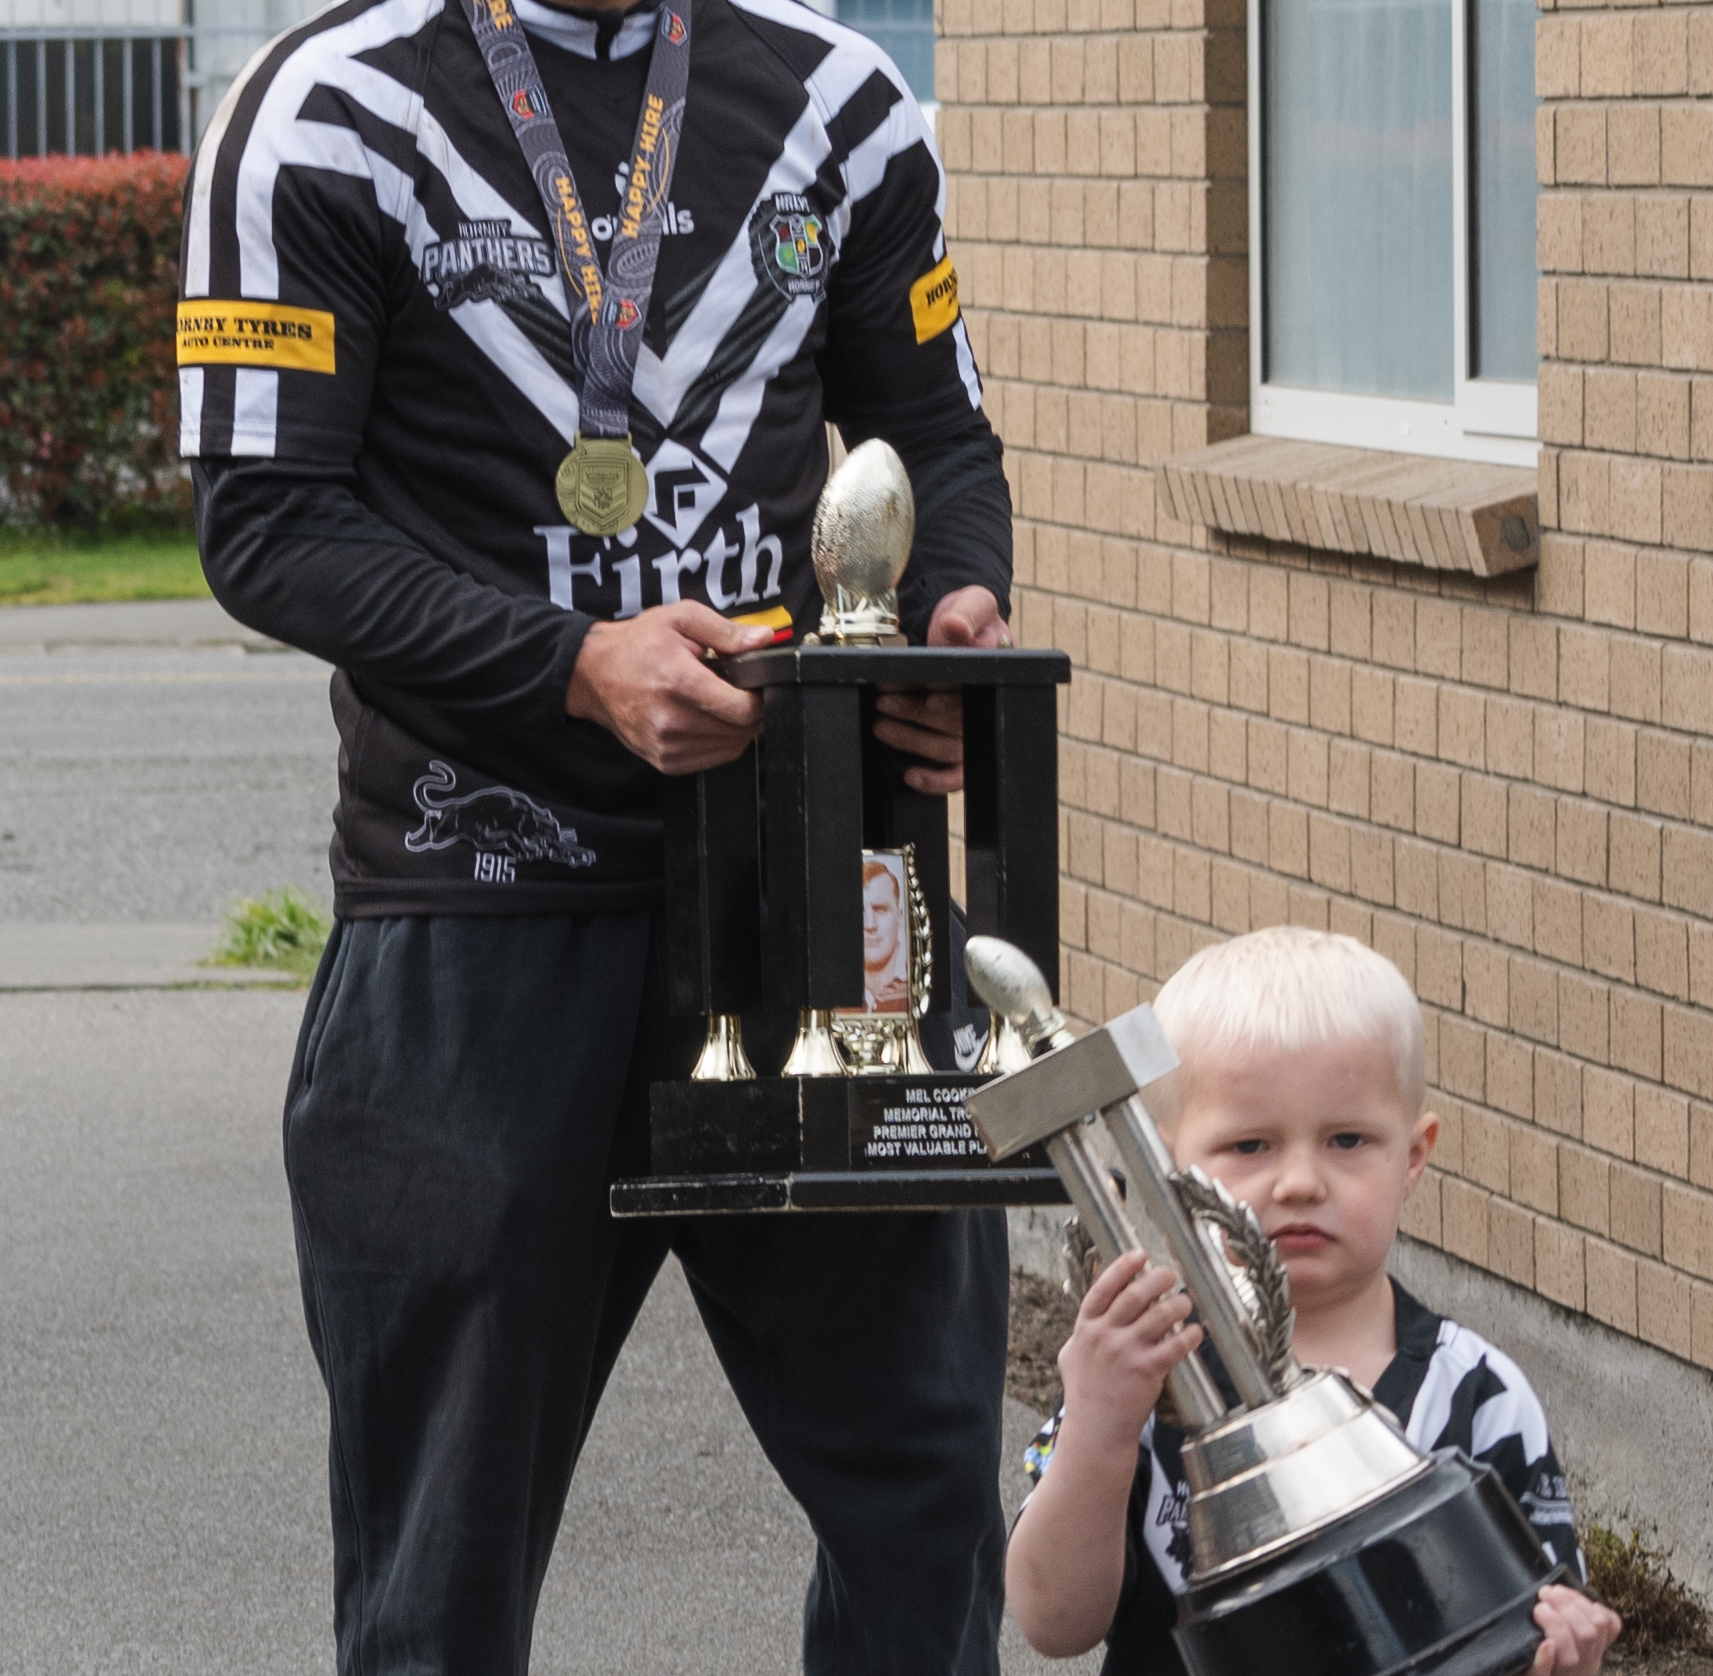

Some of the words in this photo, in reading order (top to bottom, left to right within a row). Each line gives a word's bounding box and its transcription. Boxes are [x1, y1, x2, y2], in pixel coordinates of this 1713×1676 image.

[620, 154, 652, 239] HAPPY
[638, 92, 664, 153] HIRE
[424, 236, 552, 284] PANTHERS
[555, 175, 593, 259] HAPPY
[580, 263, 603, 326] HIR
[233, 318, 313, 341] TYRES
[212, 336, 275, 350] CENTRE
[533, 502, 784, 621] Firth
[474, 851, 516, 883] 1915
[905, 1088, 931, 1104] MEL
[883, 1106, 948, 1123] MEMORIAL
[873, 1125, 927, 1140] PREMIER
[929, 1123, 972, 1139] GRAND
[867, 1142, 902, 1157] MOST
[903, 1140, 967, 1156] VALUABLE
